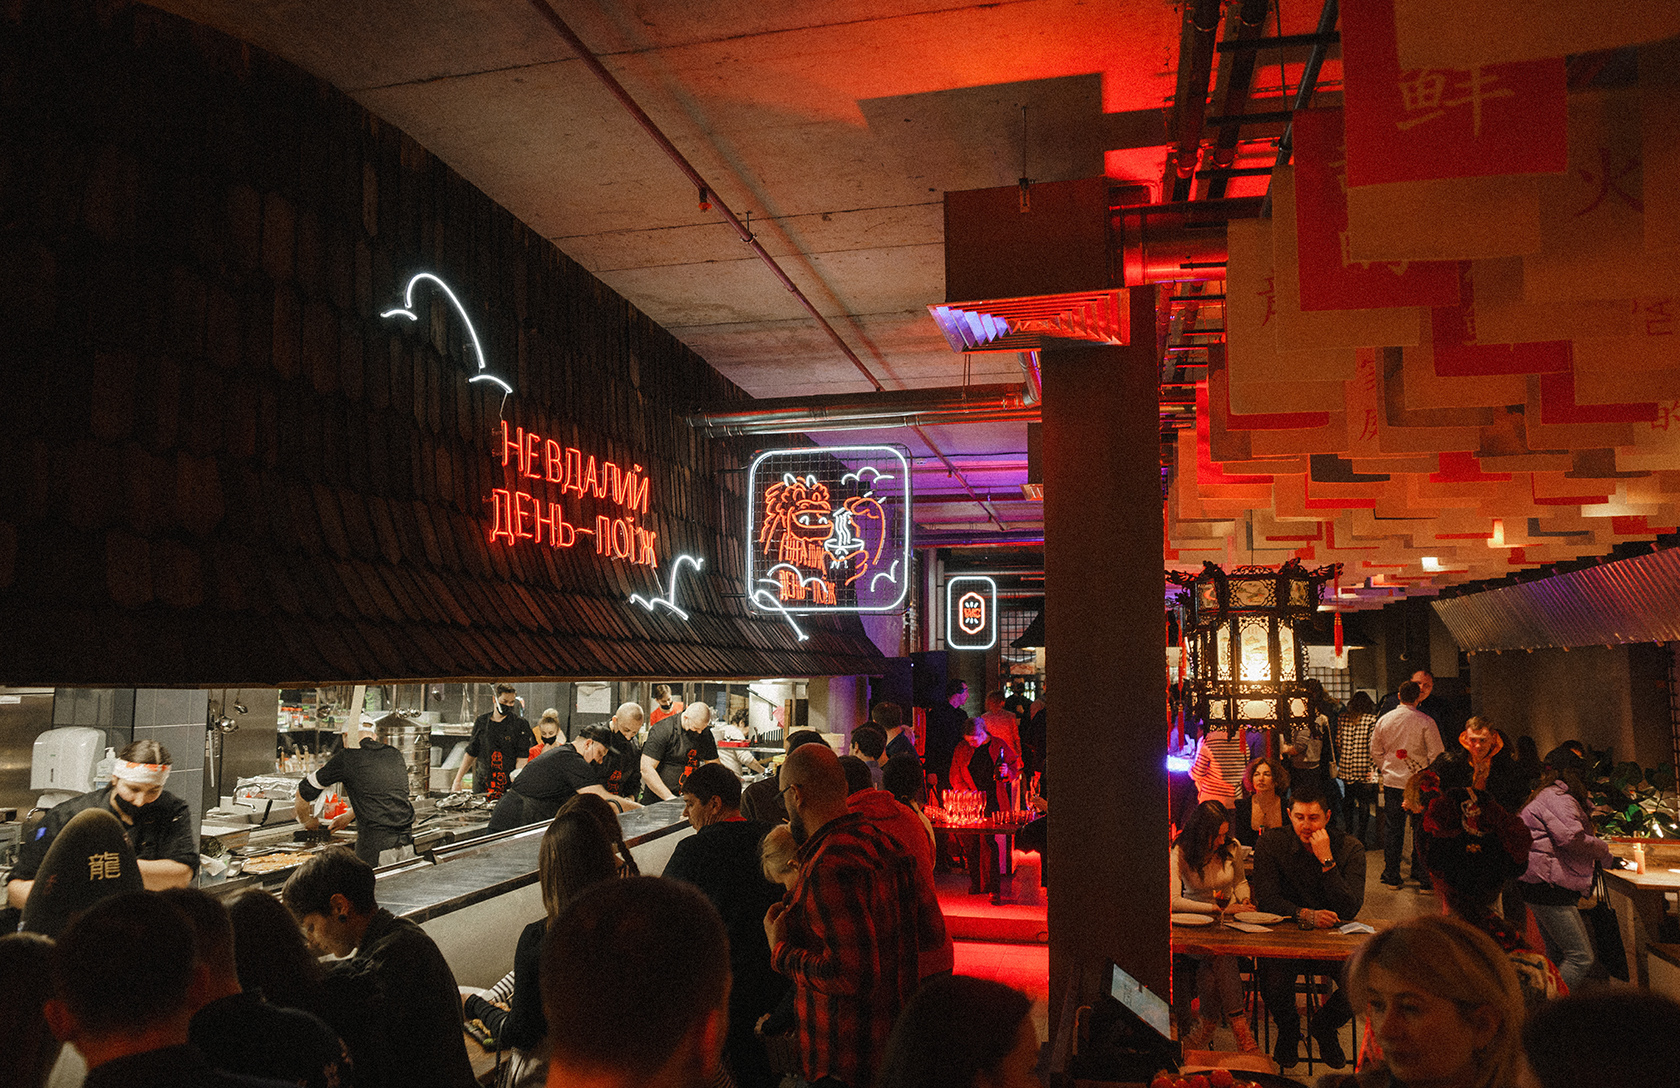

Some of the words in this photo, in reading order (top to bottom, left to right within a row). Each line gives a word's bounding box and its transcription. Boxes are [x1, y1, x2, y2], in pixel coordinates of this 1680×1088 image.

[501, 420, 649, 513] НЕВДАЛИЙ
[963, 608, 981, 618] WC
[88, 851, 121, 880] 龍
